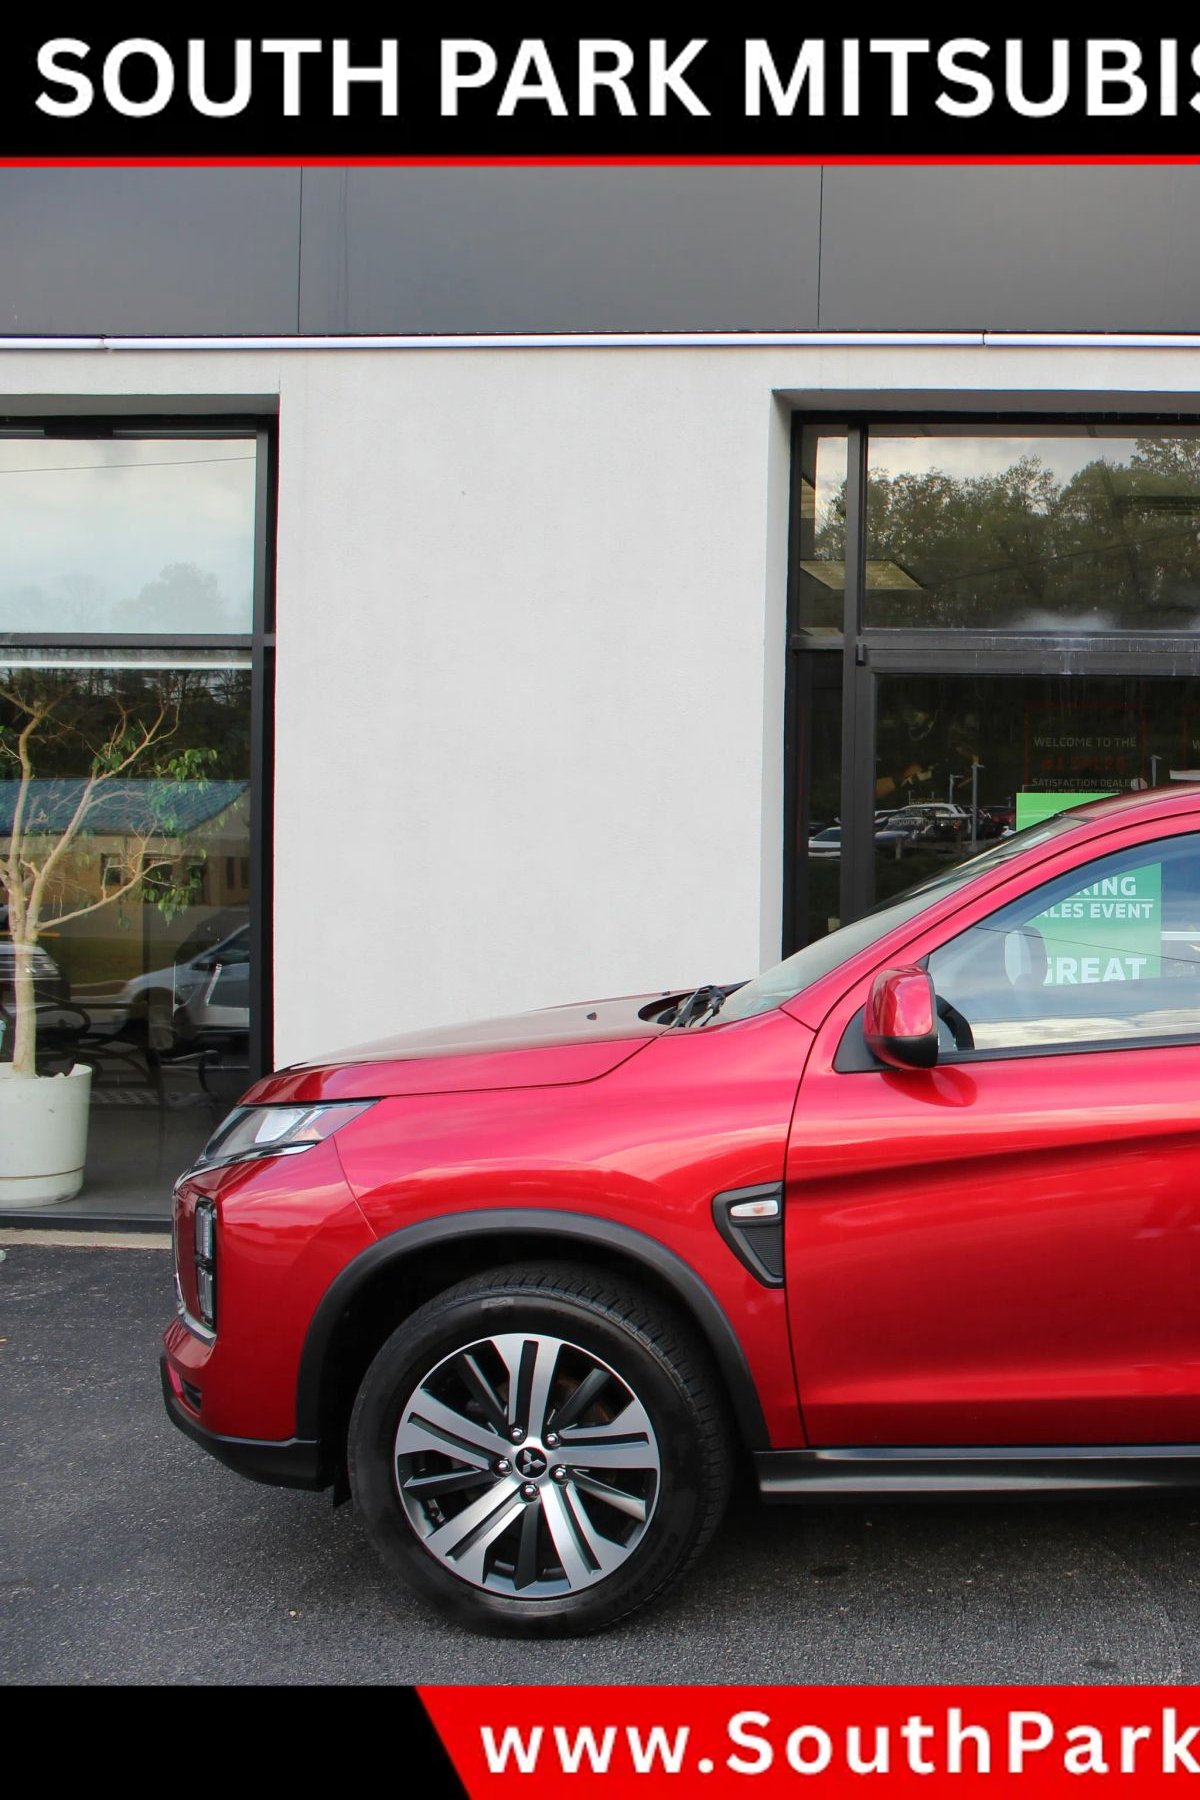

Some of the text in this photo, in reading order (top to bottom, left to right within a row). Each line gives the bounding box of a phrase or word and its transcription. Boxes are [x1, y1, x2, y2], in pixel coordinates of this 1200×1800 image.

[1033, 736, 1137, 747] WELCOME TO THE
[1032, 778, 1137, 788] SATISFACTION DEALER
[1037, 903, 1154, 919] LES EVENT
